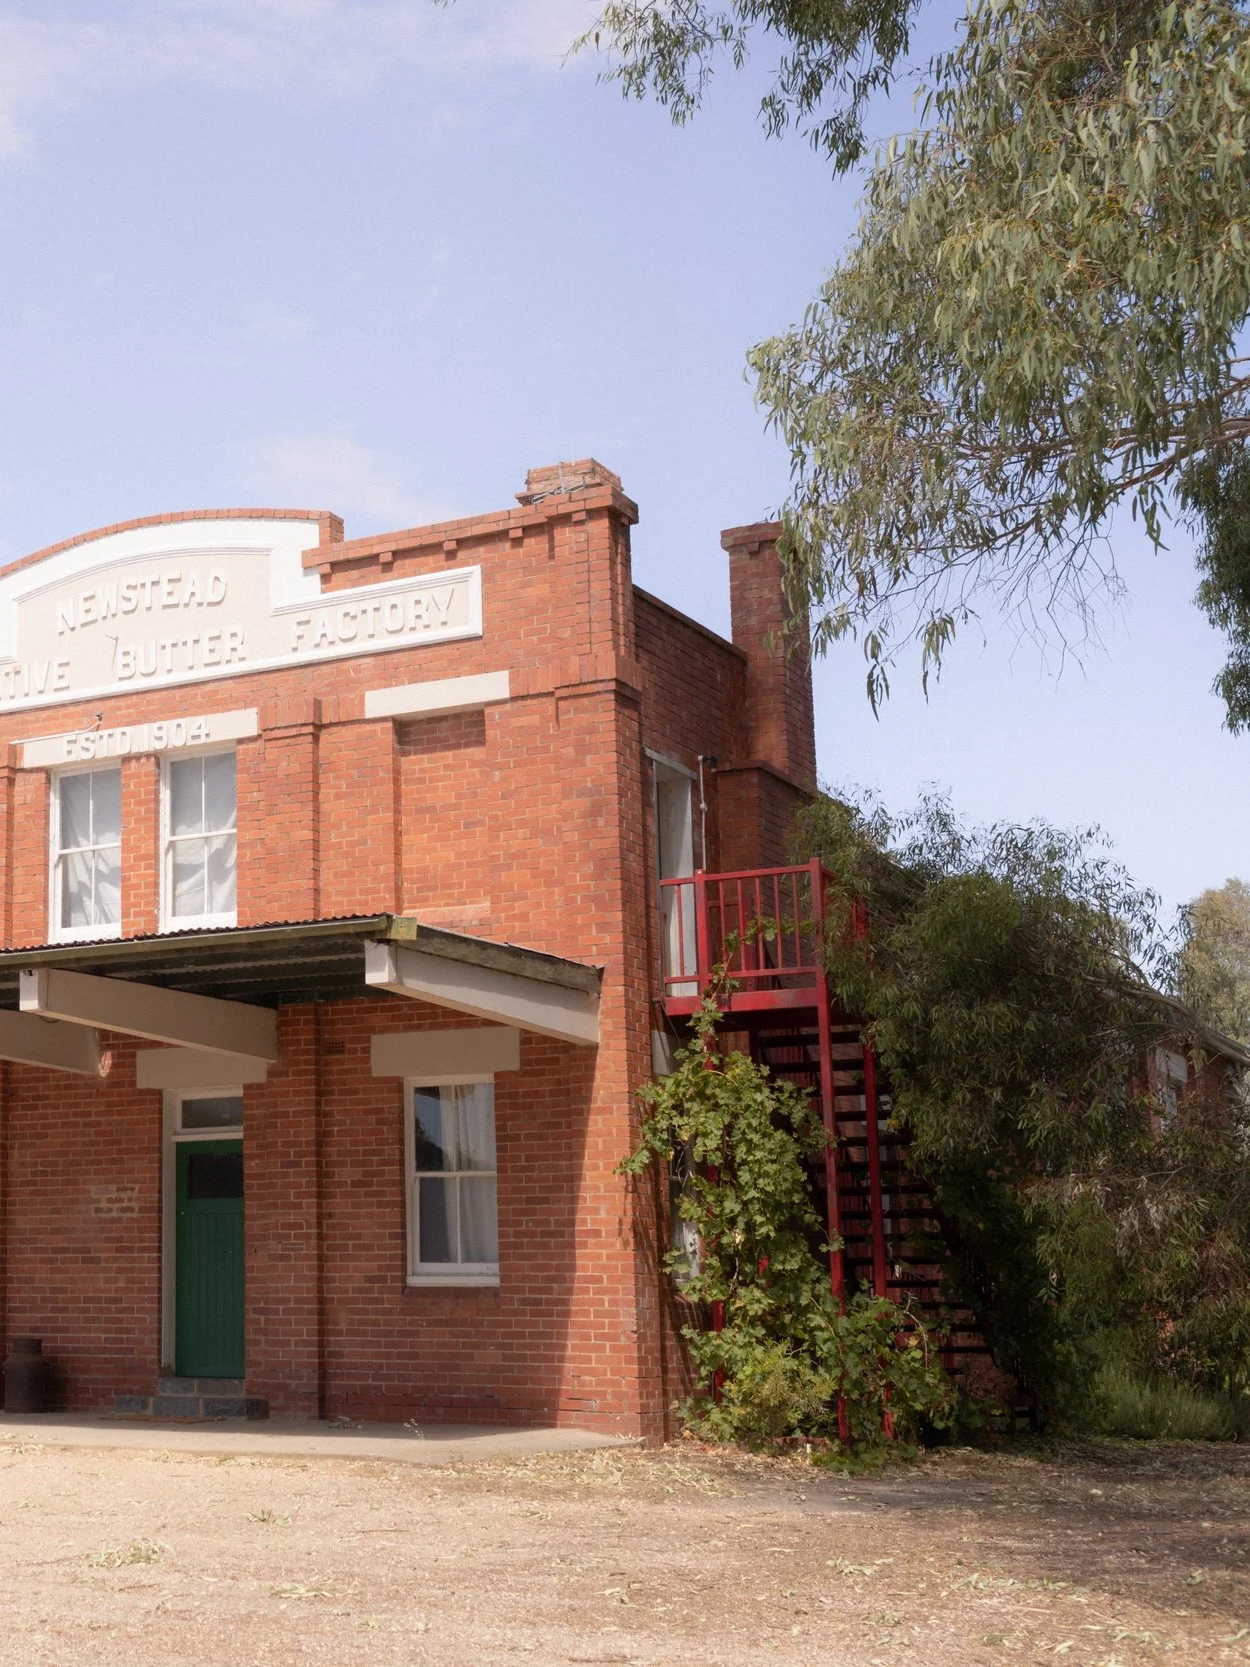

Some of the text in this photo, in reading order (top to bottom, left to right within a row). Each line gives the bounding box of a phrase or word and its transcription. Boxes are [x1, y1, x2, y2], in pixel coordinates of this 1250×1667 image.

[56, 569, 227, 636] NEWSTEAD
[118, 626, 246, 681] BUTTER
[292, 586, 455, 652] FACTORY
[144, 715, 211, 750] 1904
